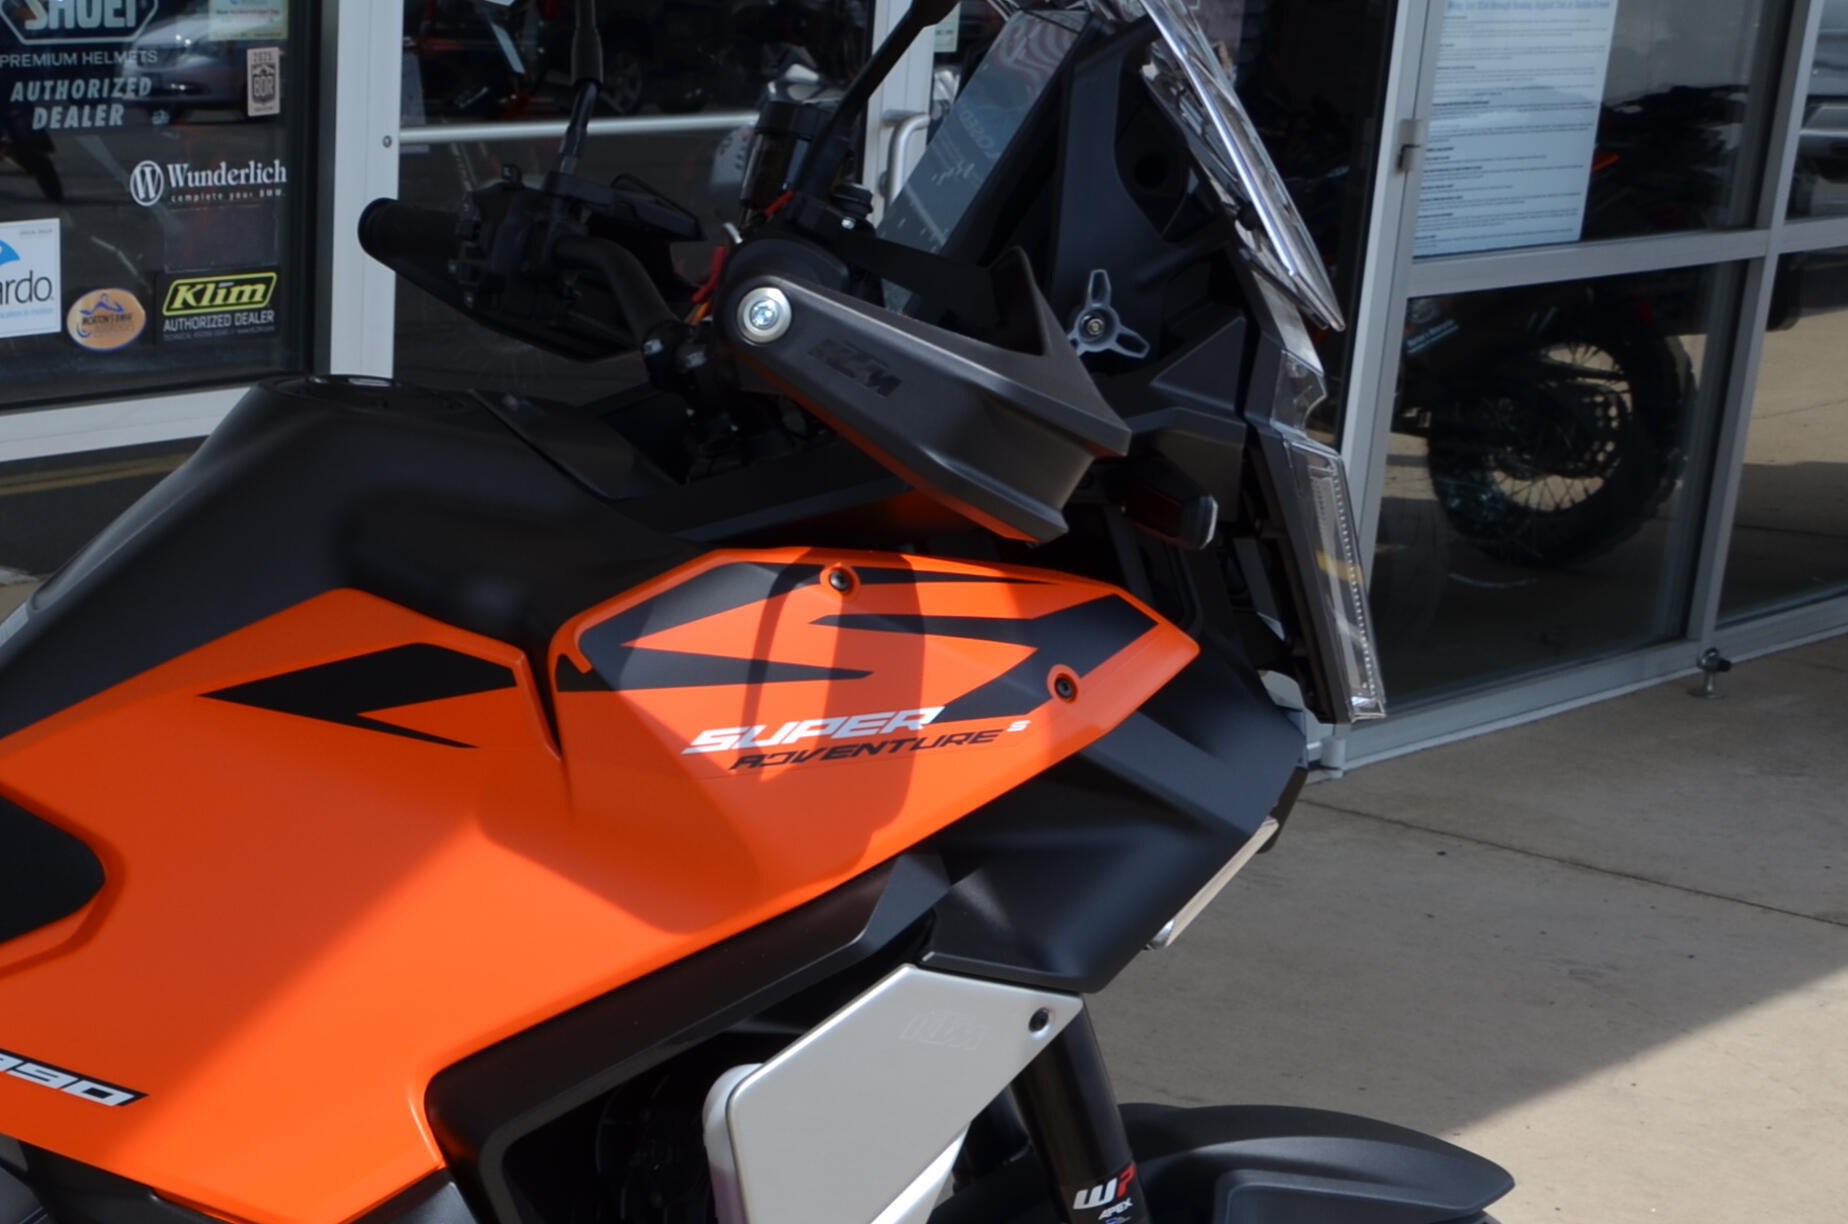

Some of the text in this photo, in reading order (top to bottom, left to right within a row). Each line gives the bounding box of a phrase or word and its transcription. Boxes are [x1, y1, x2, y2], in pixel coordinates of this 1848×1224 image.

[82, 50, 158, 66] HELMETS
[10, 76, 153, 102] AUTHORIZED
[32, 103, 125, 130] DEALER
[167, 158, 288, 189] Wunderlich
[171, 191, 224, 203] complete
[163, 310, 275, 332] AUTHORIZED DEALER
[682, 706, 945, 755] SUPER
[729, 720, 1031, 770] ADVENTURE S
[1072, 1163, 1137, 1210] WP
[1098, 1197, 1134, 1220] APEX
